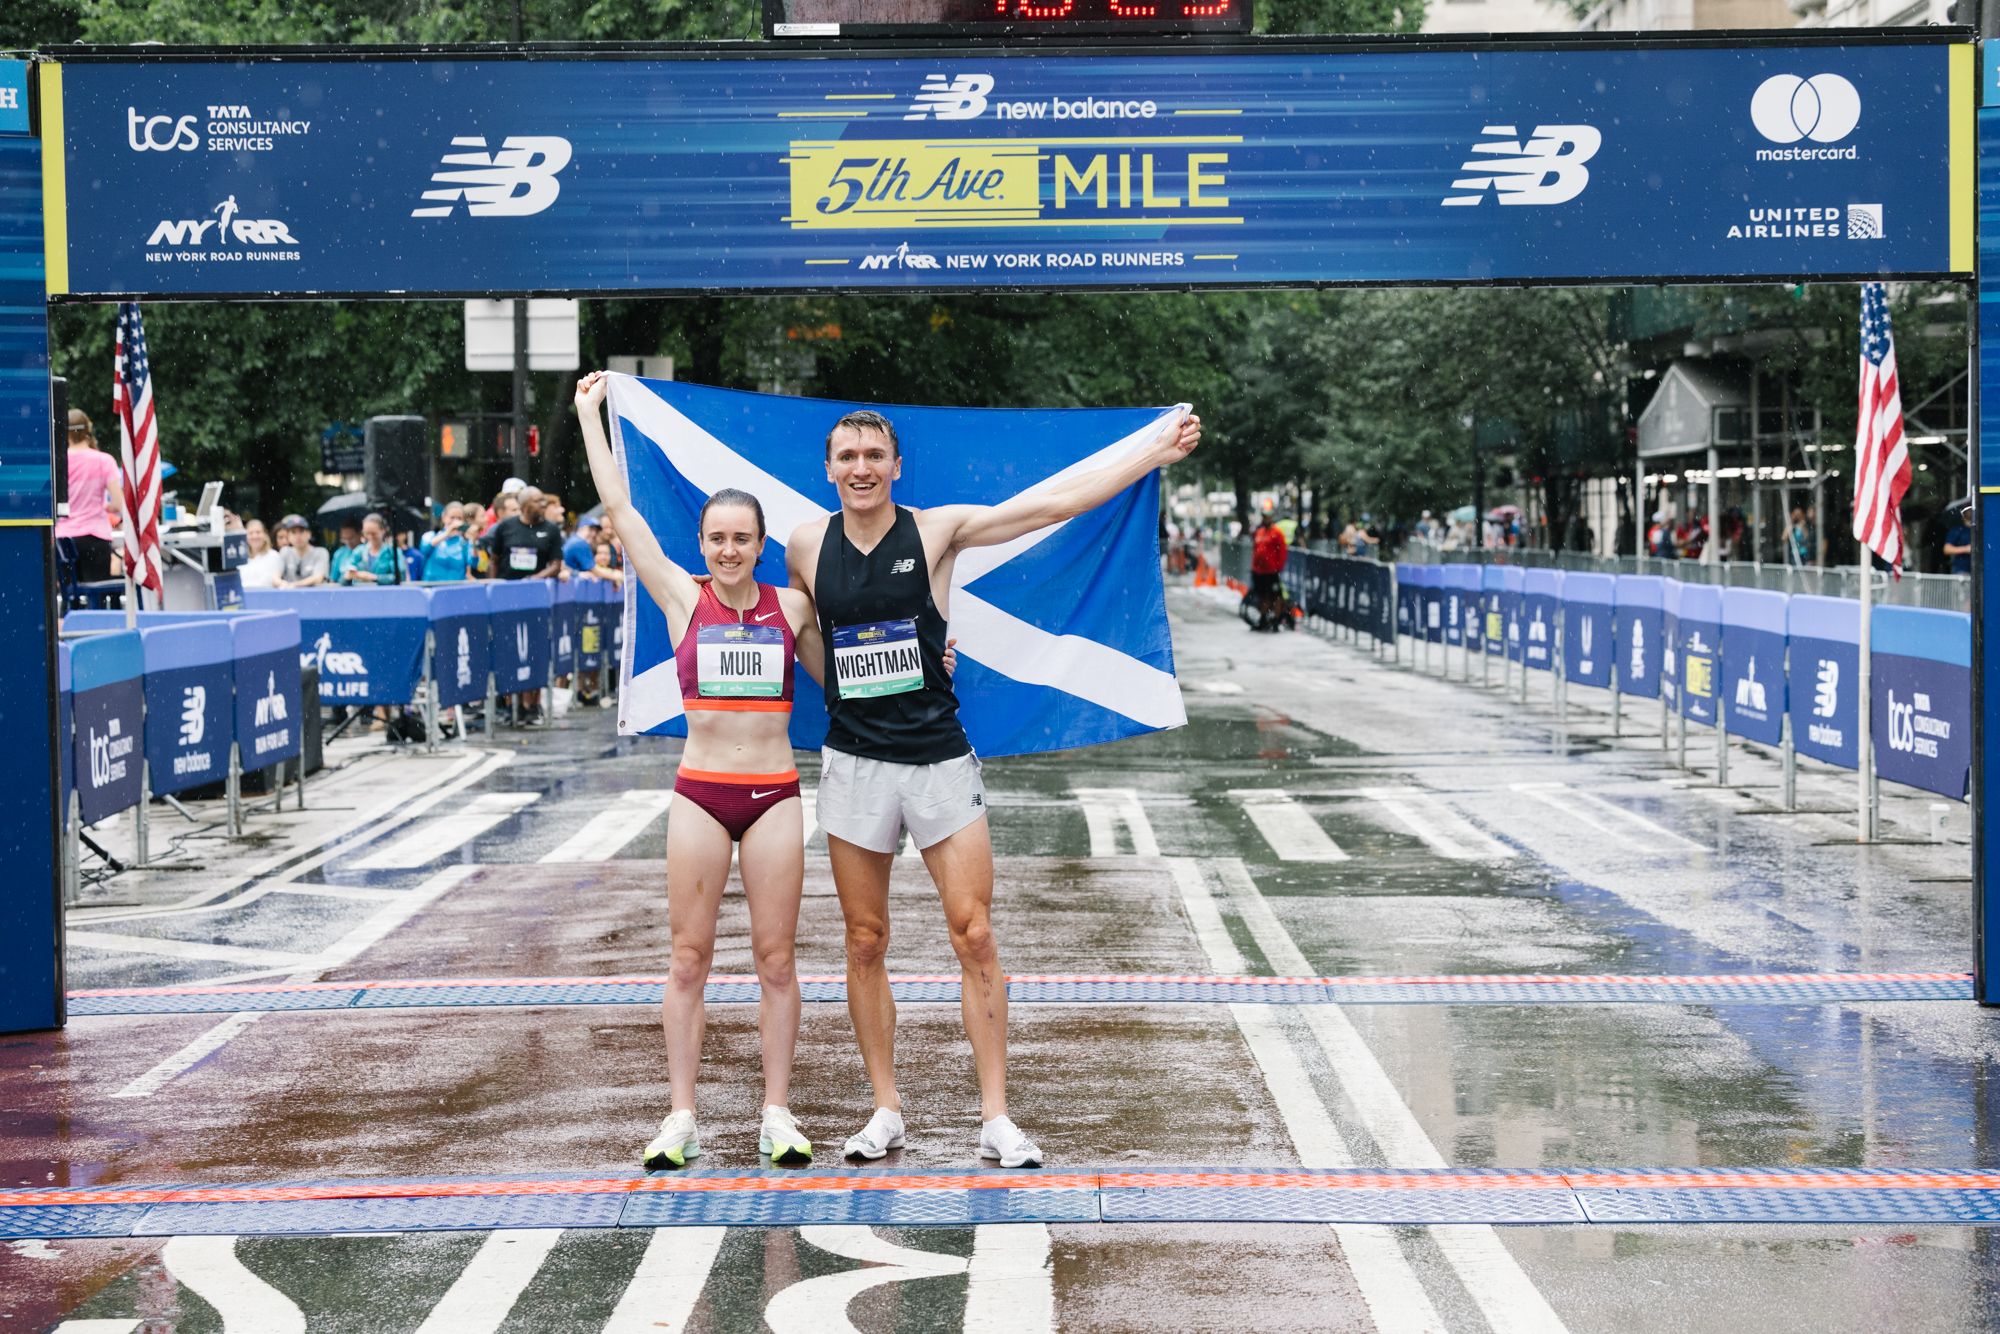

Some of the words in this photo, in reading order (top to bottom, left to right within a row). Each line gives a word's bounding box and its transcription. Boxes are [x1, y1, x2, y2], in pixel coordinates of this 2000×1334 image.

[207, 105, 251, 119] TATA
[997, 100, 1047, 120] new
[1053, 97, 1158, 119] balance
[128, 106, 199, 151] tcs
[207, 121, 310, 135] CONSULTANCY
[208, 138, 273, 151] SERVICES
[1756, 145, 1857, 161] mastercard
[816, 158, 910, 214] 5th
[912, 157, 1005, 201] Ave.
[1055, 153, 1229, 208] MILE
[1750, 208, 1840, 222] UNITED
[1726, 224, 1840, 238] AIRLINES
[145, 252, 172, 262] NEW
[176, 251, 206, 262] YORK
[210, 251, 242, 261] ROAD
[246, 251, 300, 261] RUNNERS
[946, 254, 988, 268] NEW
[995, 254, 1041, 267] YORK
[1047, 253, 1096, 267] ROAD
[1102, 252, 1185, 266] RUNNERS
[720, 651, 762, 676] MUIR
[836, 646, 920, 680] WIGHTMAN
[337, 682, 369, 697] LIFE
[1888, 689, 1914, 753] tcs
[90, 727, 110, 788] tcs
